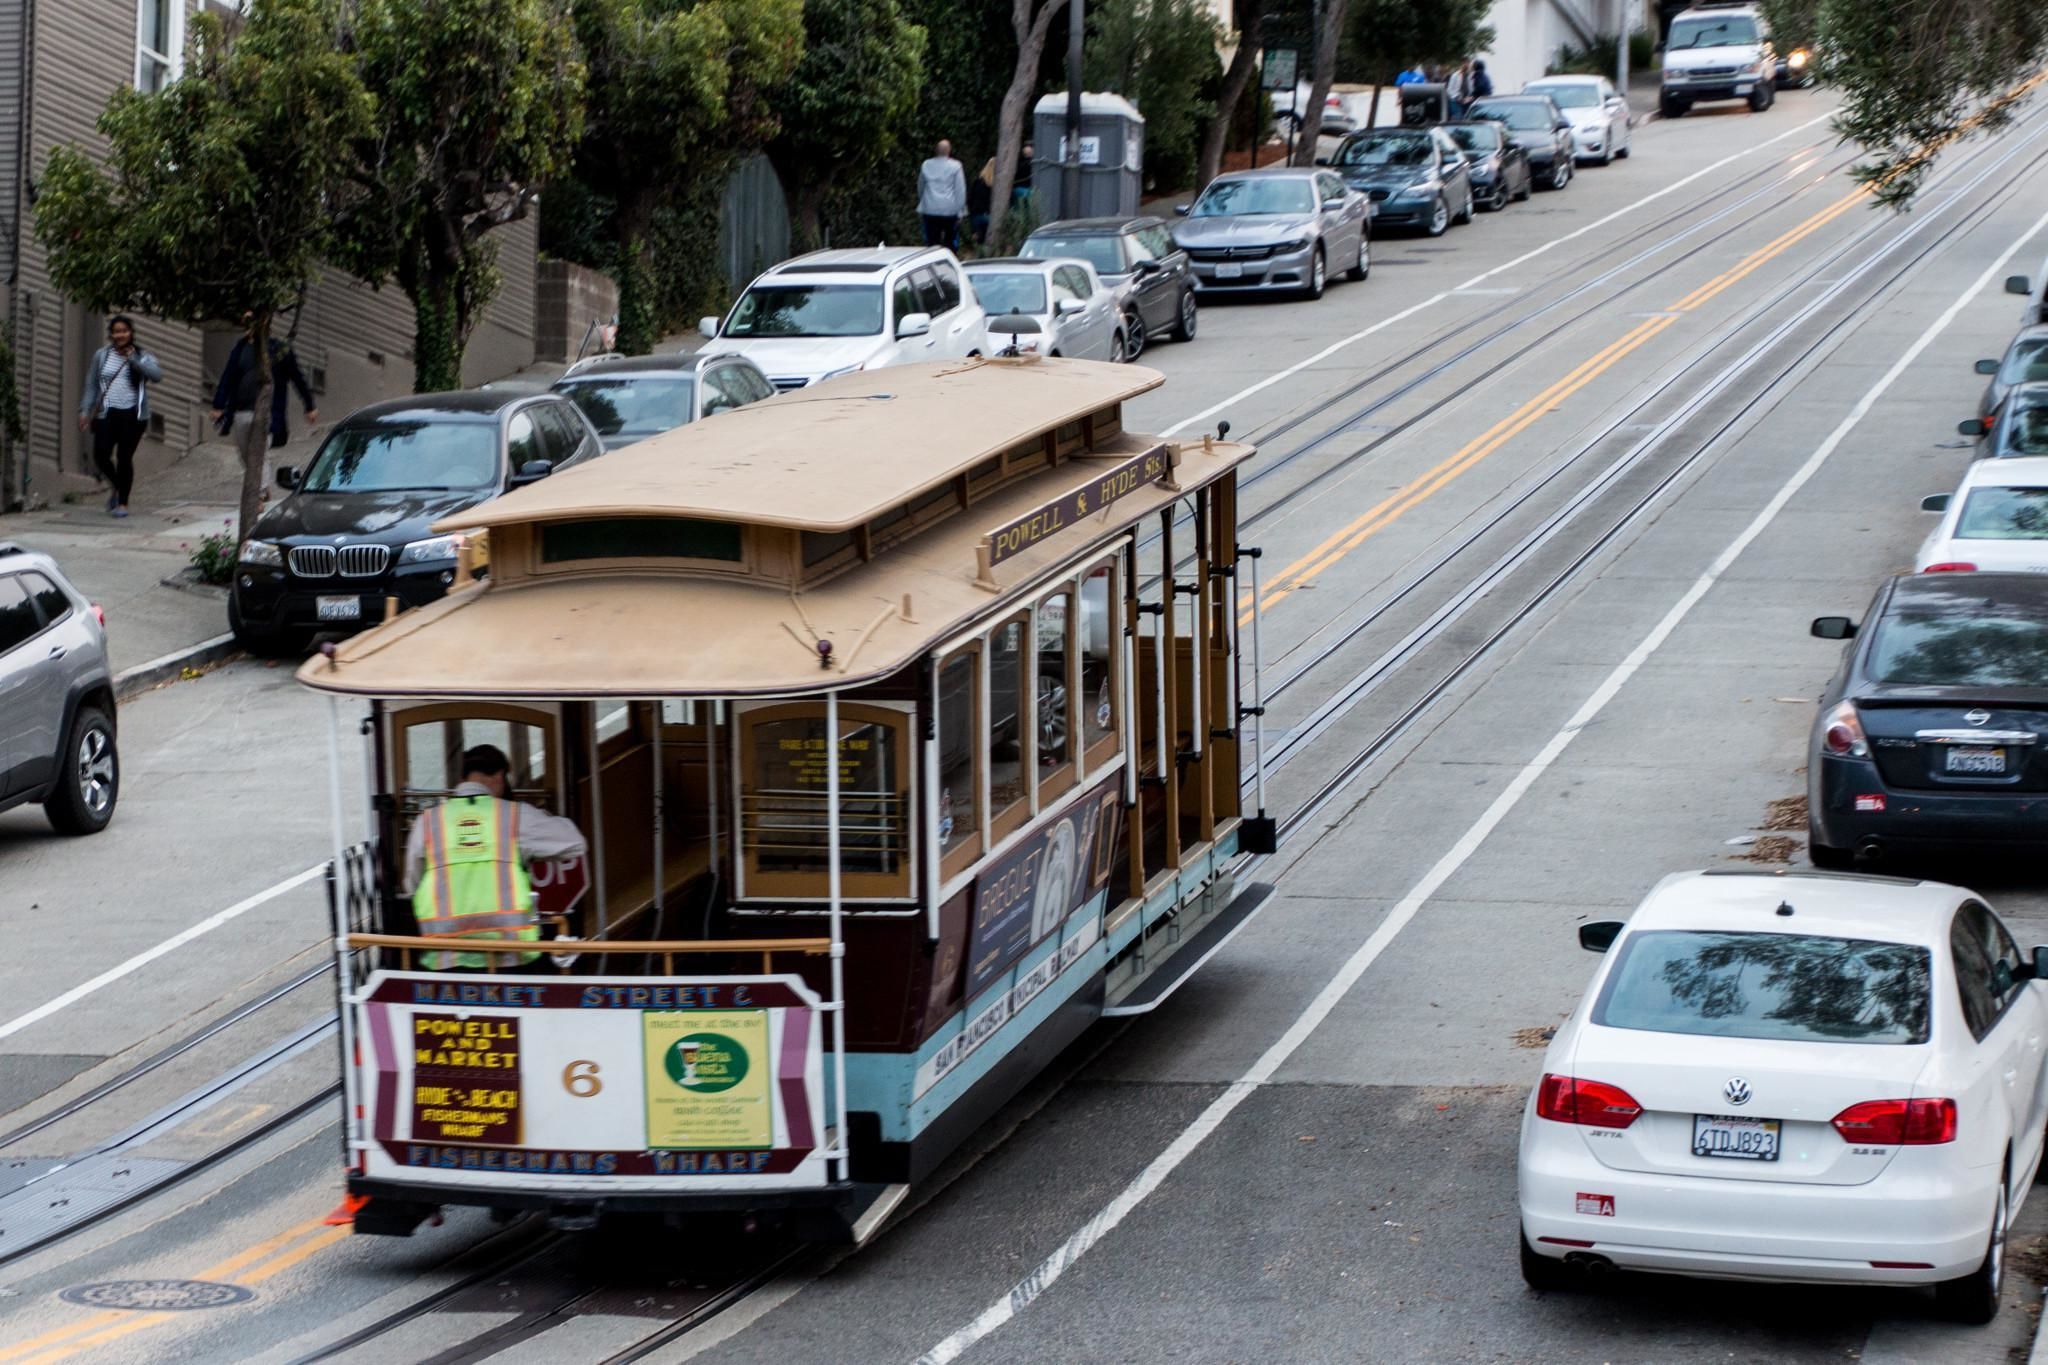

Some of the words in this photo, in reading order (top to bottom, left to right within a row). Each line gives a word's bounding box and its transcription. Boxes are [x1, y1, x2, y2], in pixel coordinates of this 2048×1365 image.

[995, 507, 1063, 558] POWELL
[1077, 491, 1087, 517] &
[1101, 465, 1138, 503] HYDE
[979, 847, 1042, 929] BREGUET
[413, 983, 547, 1007] MARKET
[580, 985, 720, 1008] STREET
[415, 1019, 516, 1039] POWELL
[440, 1038, 492, 1050] AND
[415, 1049, 518, 1068] MARKET
[562, 1059, 603, 1098] 6
[416, 1086, 452, 1105] HYDE
[470, 1089, 518, 1109] BEACH
[441, 1124, 488, 1137] WHARF
[1590, 1130, 1623, 1138] JETTA
[1698, 1128, 1774, 1153] 6TDJ893
[408, 1145, 617, 1174] FISHERMANS
[654, 1151, 771, 1174] WHARF
[1601, 1199, 1614, 1215] A
